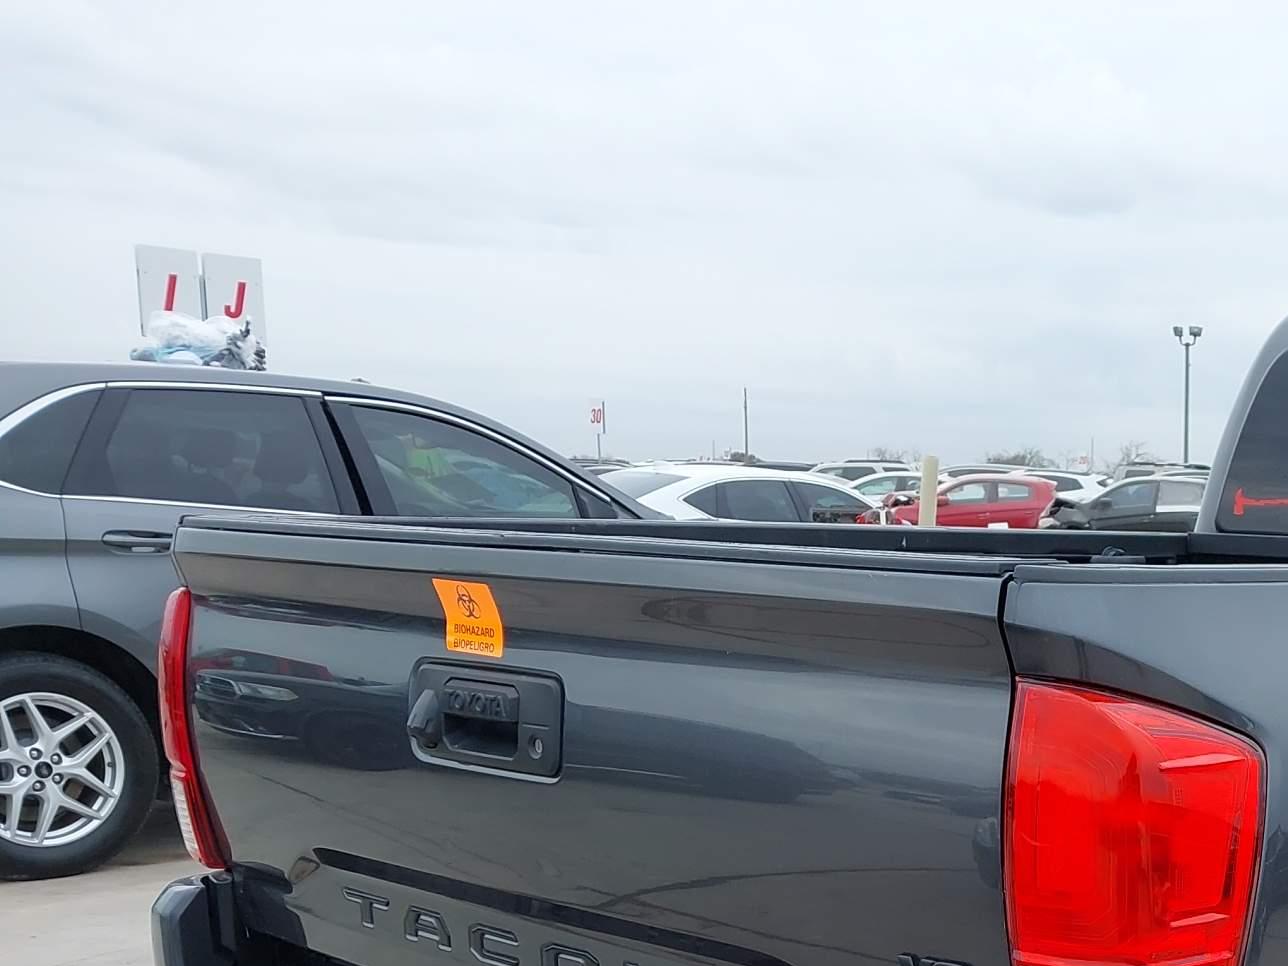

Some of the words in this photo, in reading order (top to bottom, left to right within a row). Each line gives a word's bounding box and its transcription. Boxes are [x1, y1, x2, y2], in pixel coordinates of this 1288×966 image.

[223, 281, 247, 319] J
[590, 407, 602, 424] 30
[453, 623, 495, 638] BIOHAZARD
[453, 638, 495, 653] BIOPELIGRO
[444, 688, 508, 718] TOYOTA
